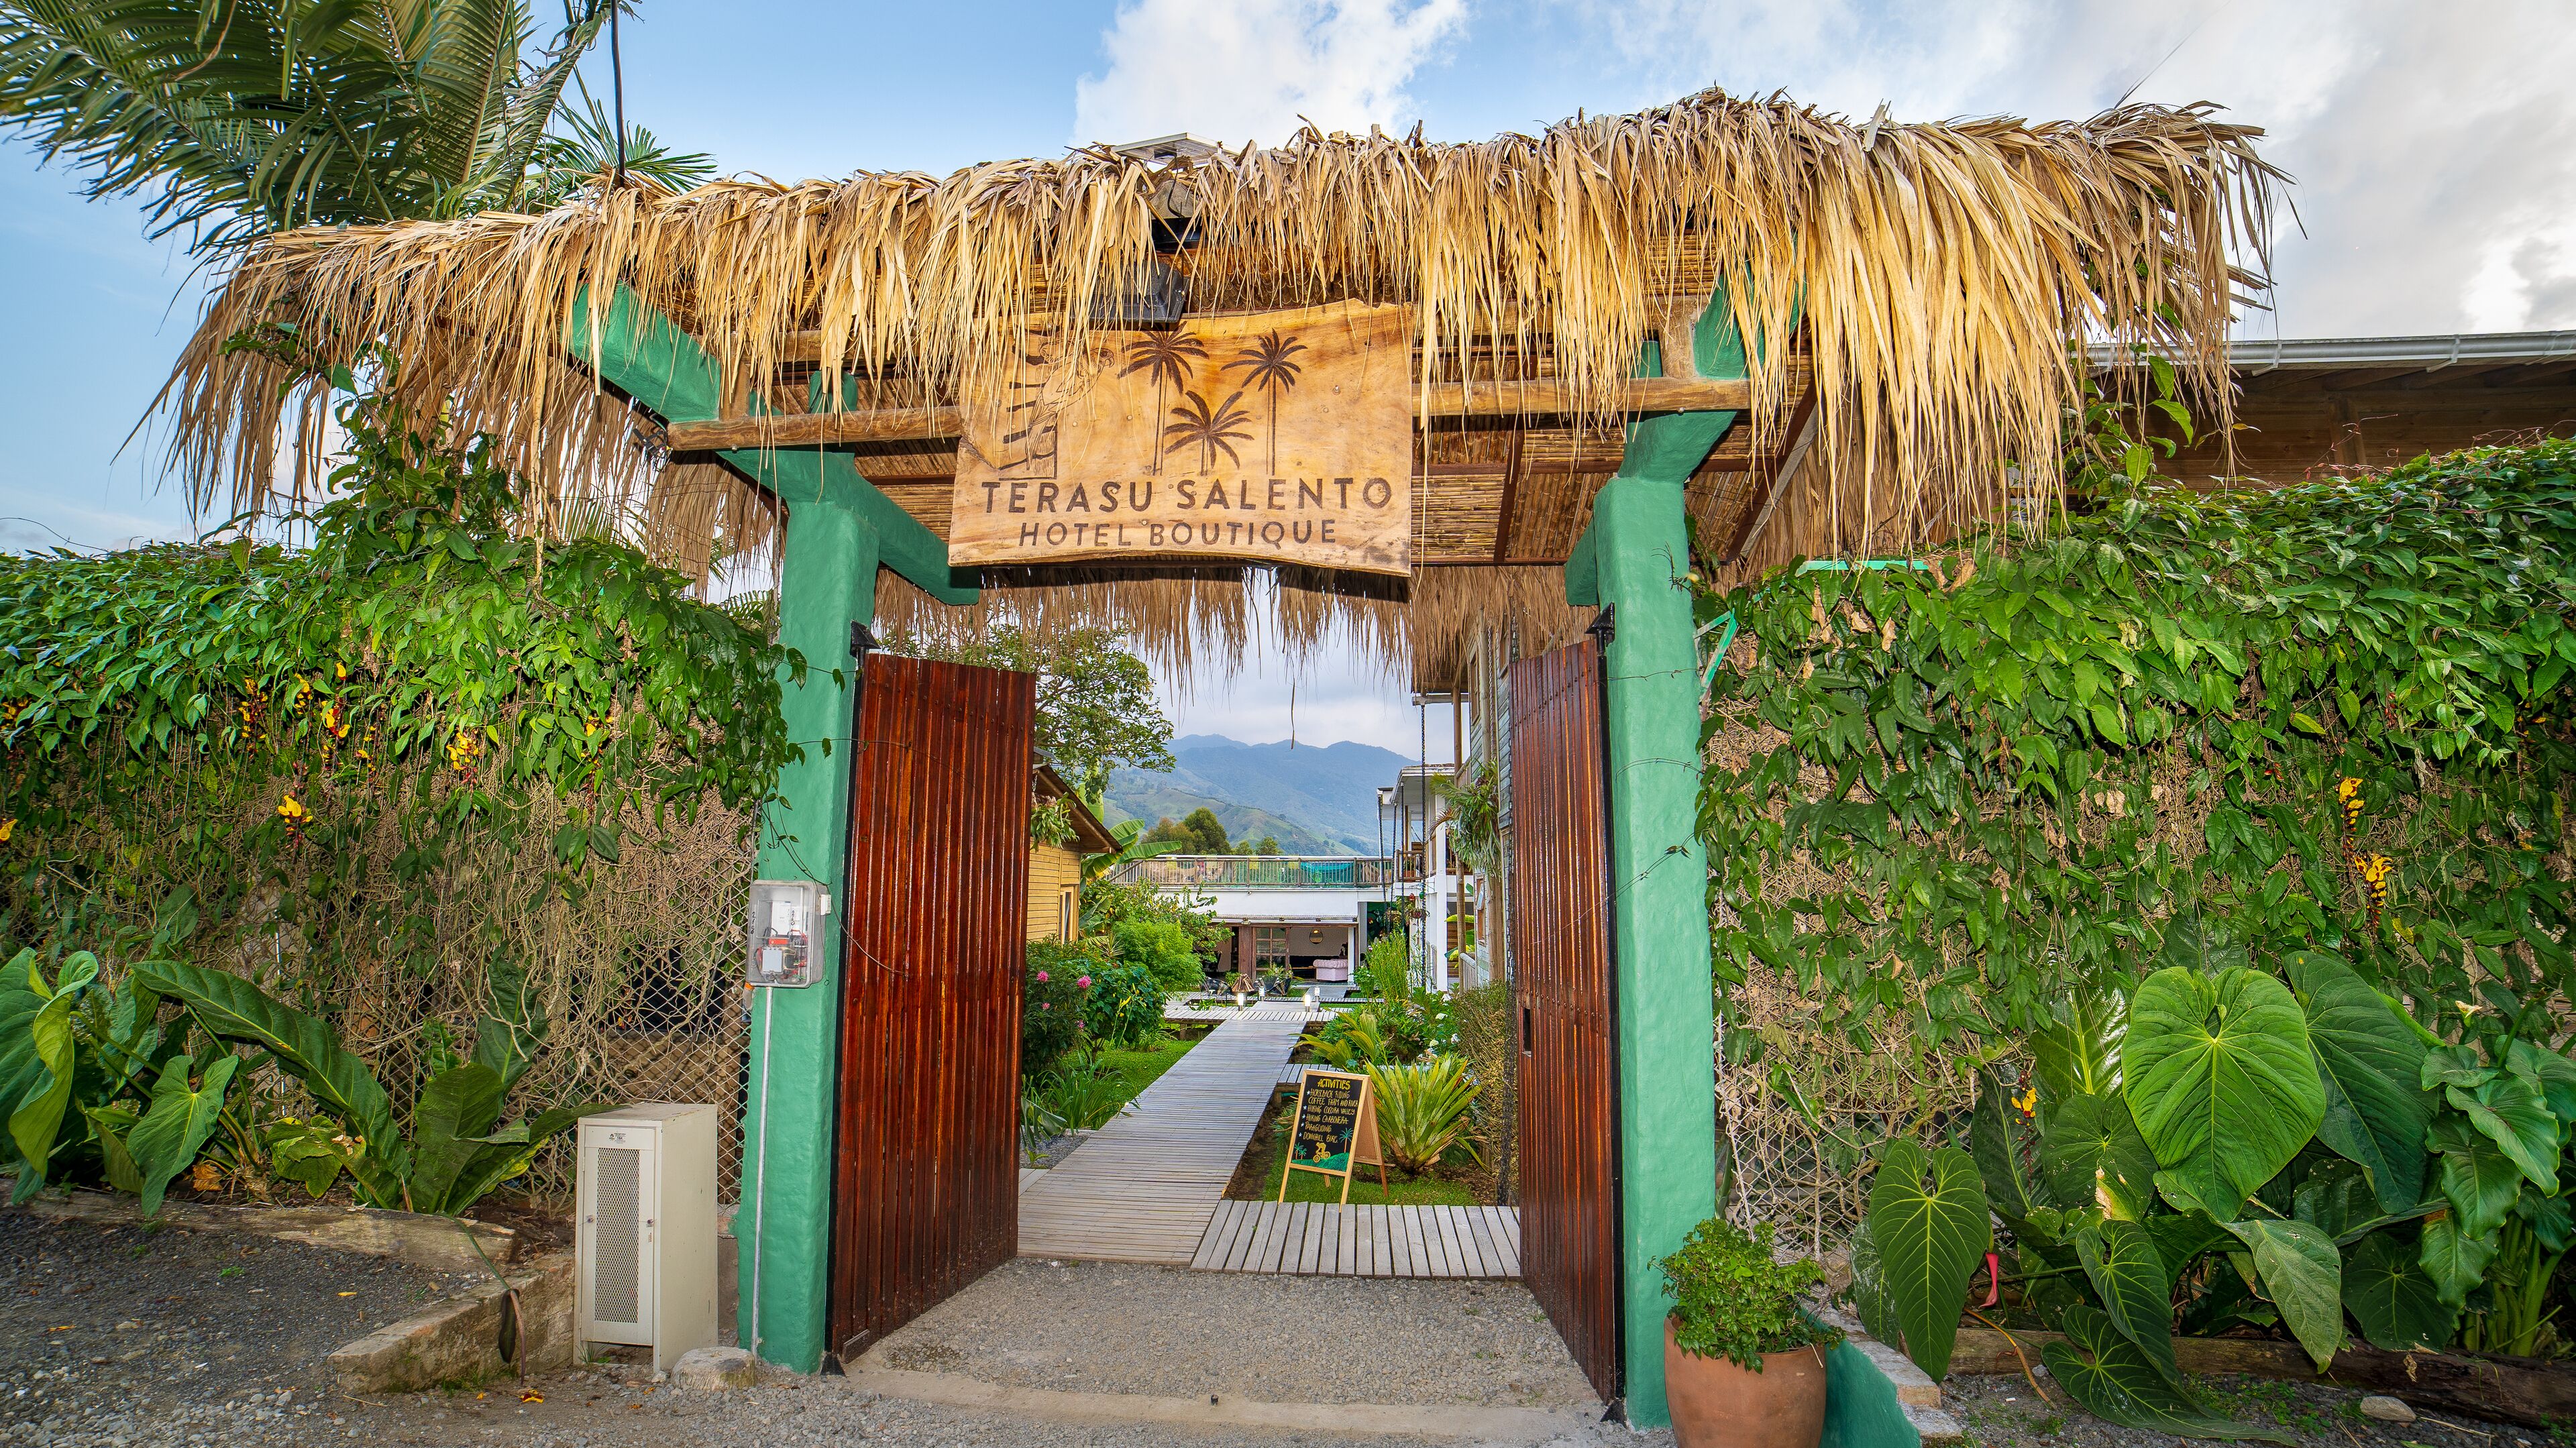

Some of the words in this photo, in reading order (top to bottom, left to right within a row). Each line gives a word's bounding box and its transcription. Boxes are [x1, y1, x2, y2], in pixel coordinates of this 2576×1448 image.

[981, 480, 1152, 514] TERASU
[1176, 477, 1392, 511] SALENTO
[1018, 521, 1132, 547] HOTEL
[1150, 518, 1337, 549] BOUTIQUE
[1318, 1078, 1350, 1090] ACTIVITIES
[1310, 1088, 1333, 1098] HORSEBACK
[1335, 1091, 1350, 1099] RIDING
[1308, 1097, 1325, 1105] COFFEE
[1328, 1098, 1340, 1106] FARM
[1307, 1104, 1322, 1113] HIKING
[1324, 1106, 1339, 1114] COCORA
[1306, 1113, 1321, 1122] HIKING
[1322, 1115, 1348, 1124] CARBONERA
[1305, 1121, 1332, 1133] PARAGLIDING
[1303, 1132, 1323, 1141] DOWNHILL
